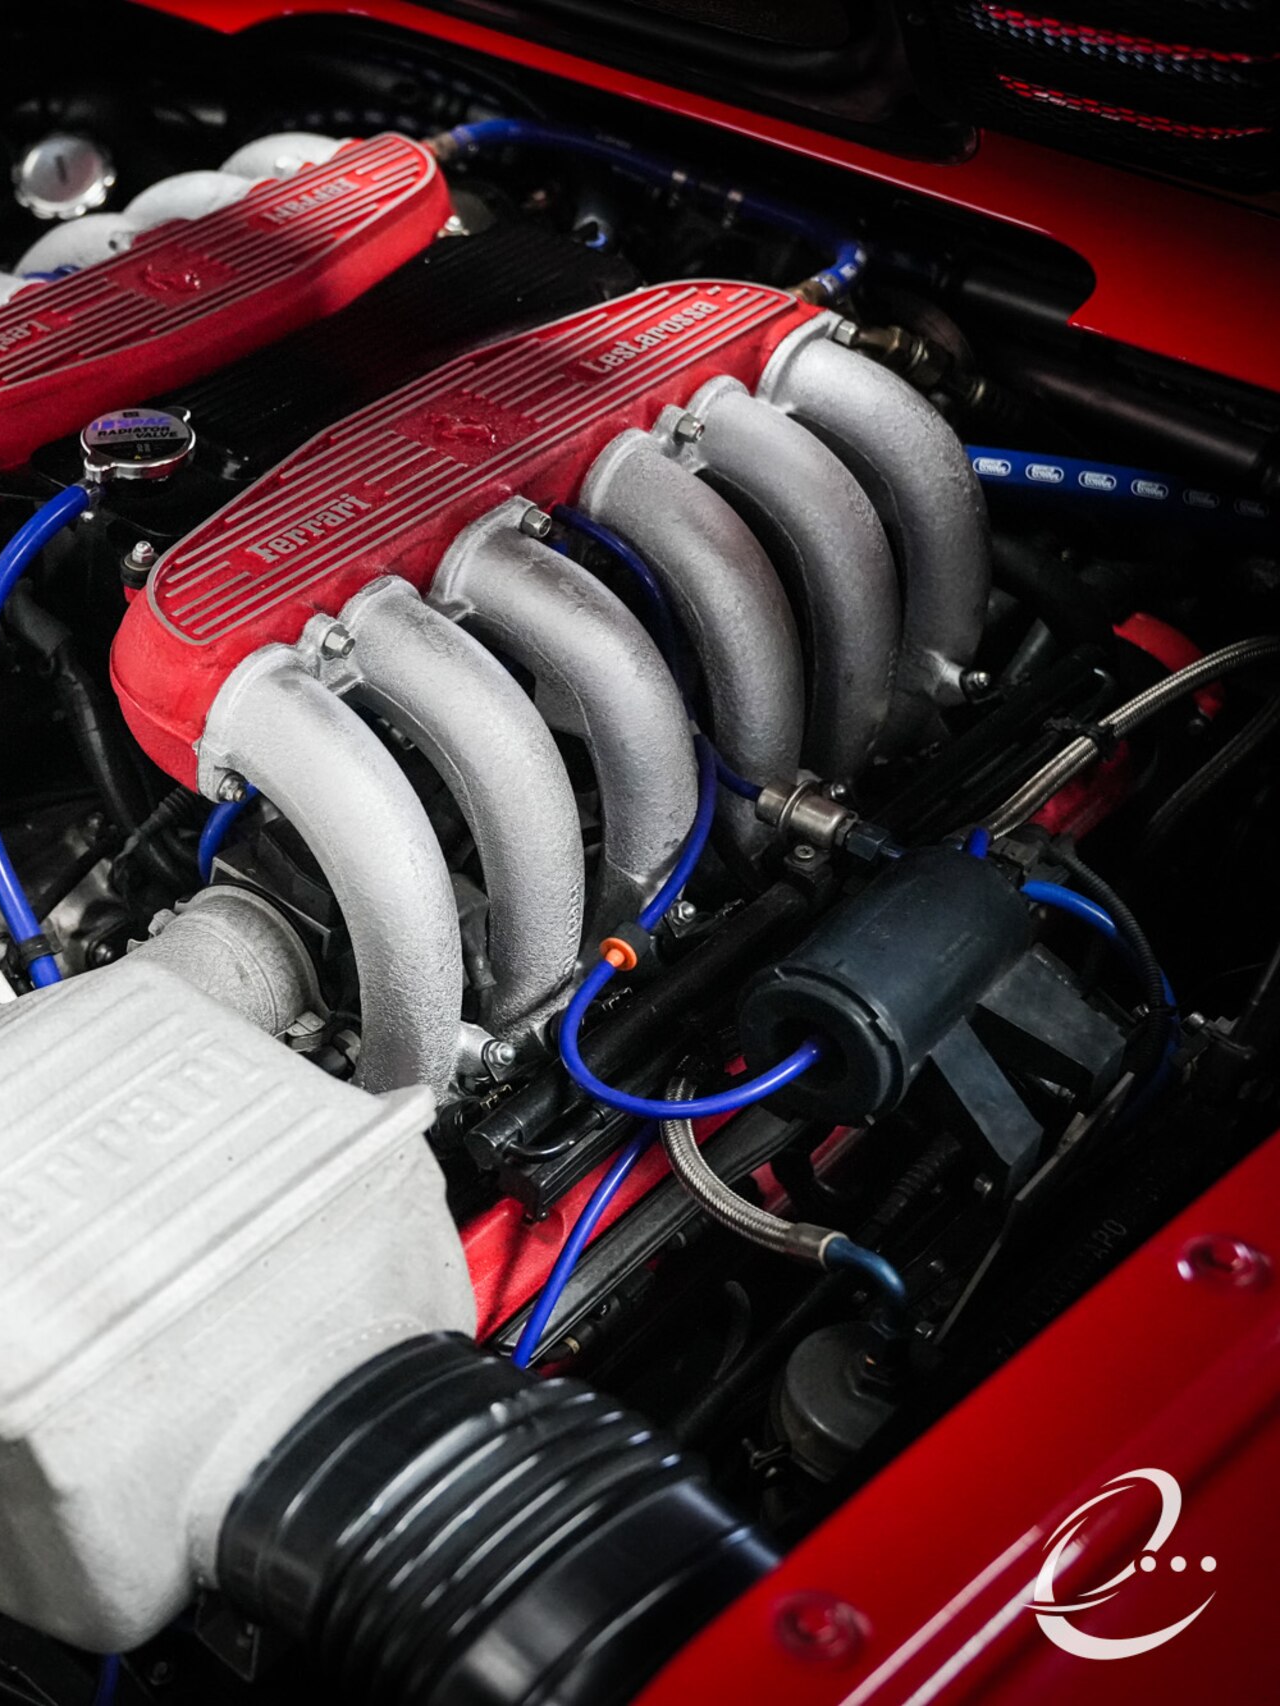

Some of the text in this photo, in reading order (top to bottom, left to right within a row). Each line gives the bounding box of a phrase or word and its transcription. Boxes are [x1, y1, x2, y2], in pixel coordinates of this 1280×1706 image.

[259, 175, 360, 225] Ferrari
[97, 426, 171, 437] RADIATOR
[135, 431, 178, 439] VALVE
[244, 491, 372, 565] Ferrari
